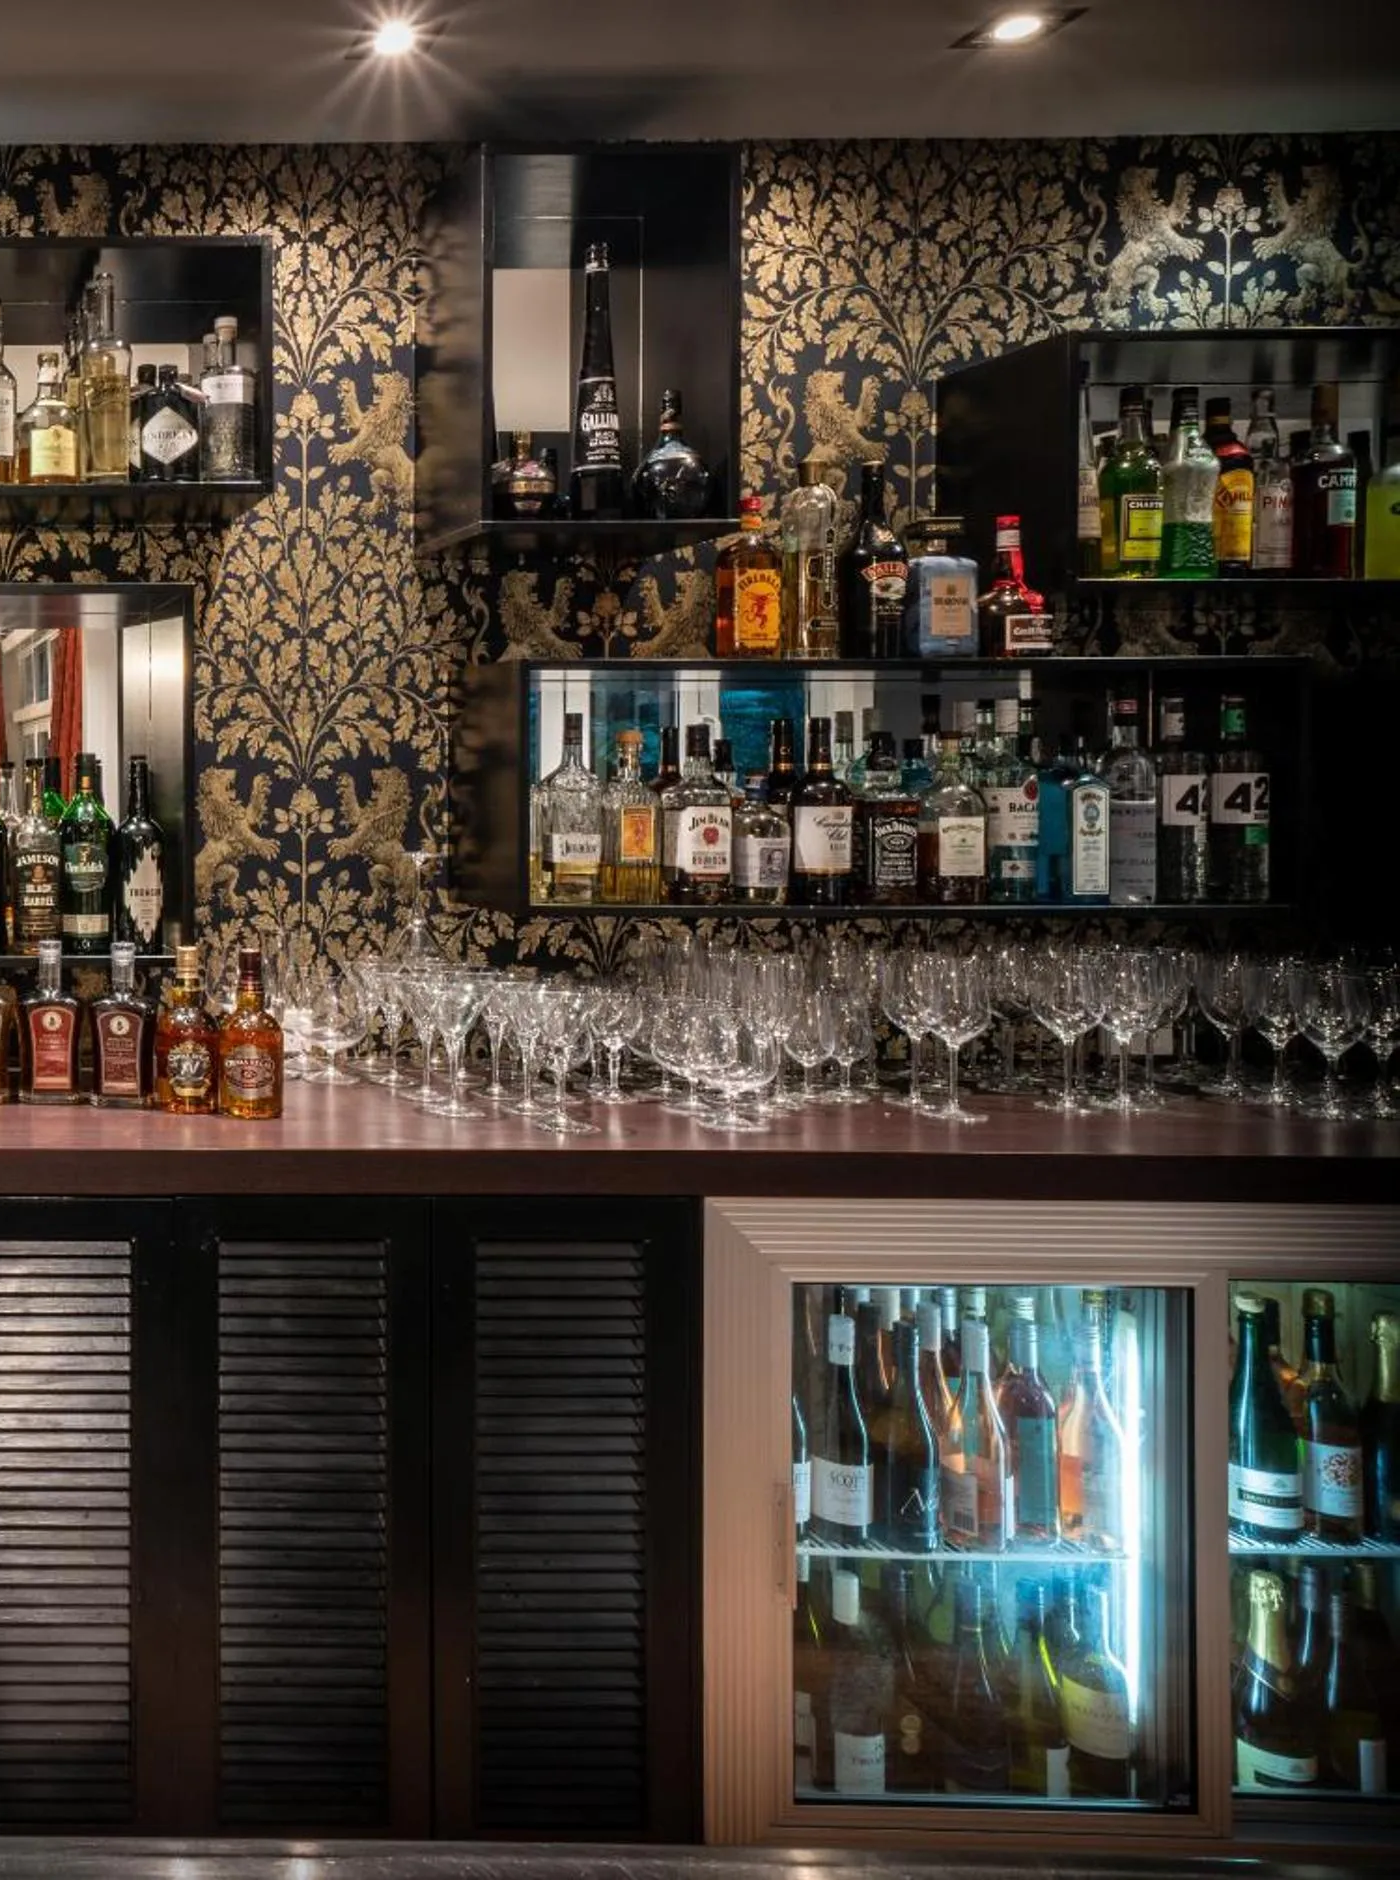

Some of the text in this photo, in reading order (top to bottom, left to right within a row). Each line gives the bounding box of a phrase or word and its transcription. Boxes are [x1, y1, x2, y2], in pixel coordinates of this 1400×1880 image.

[1224, 775, 1269, 814] 42
[689, 814, 707, 831] JIM
[16, 854, 60, 867] JAMESON
[180, 1061, 200, 1076] XV
